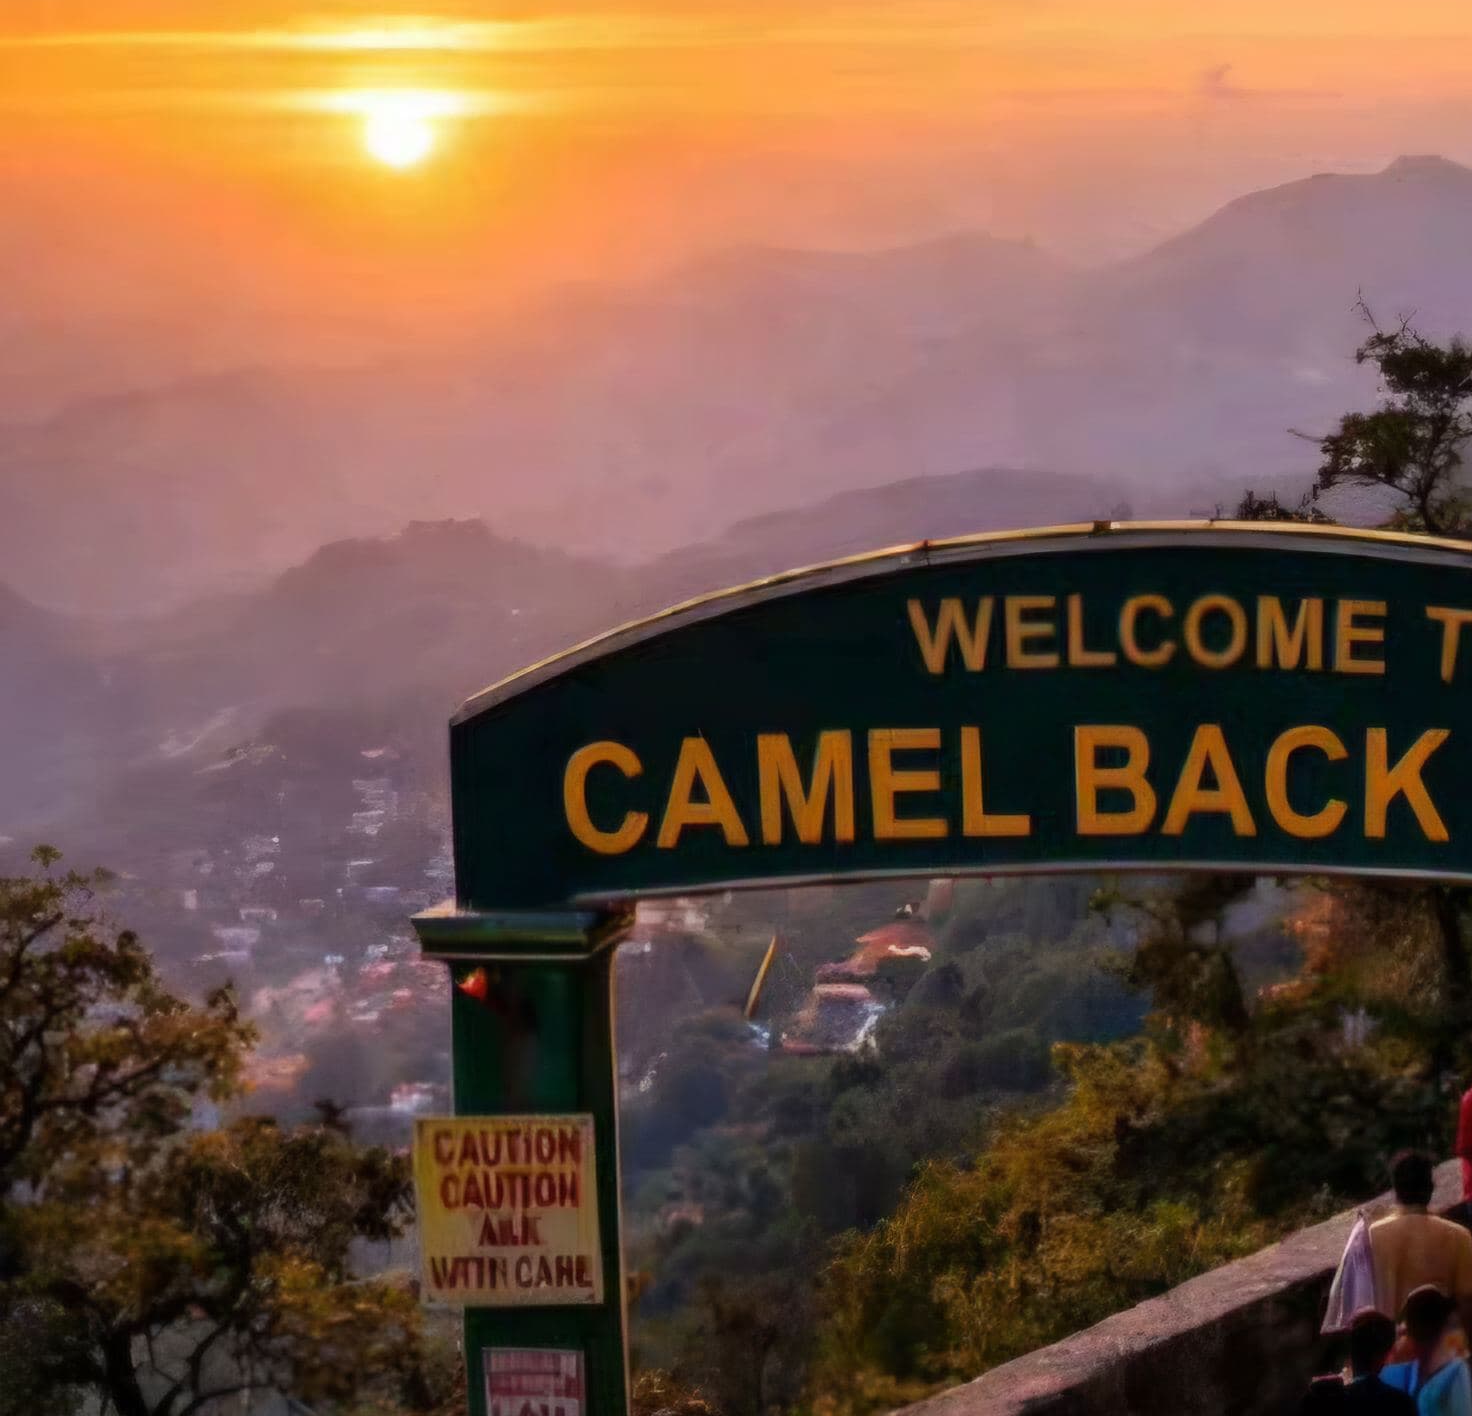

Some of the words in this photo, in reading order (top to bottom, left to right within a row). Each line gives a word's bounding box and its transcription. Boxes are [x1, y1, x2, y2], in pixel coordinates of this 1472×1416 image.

[908, 595, 1387, 674] WELCOME
[563, 726, 1031, 854] CAMEL
[1074, 724, 1450, 841] BACK
[434, 1128, 581, 1167] CAUTION
[440, 1170, 580, 1210] CAUTION
